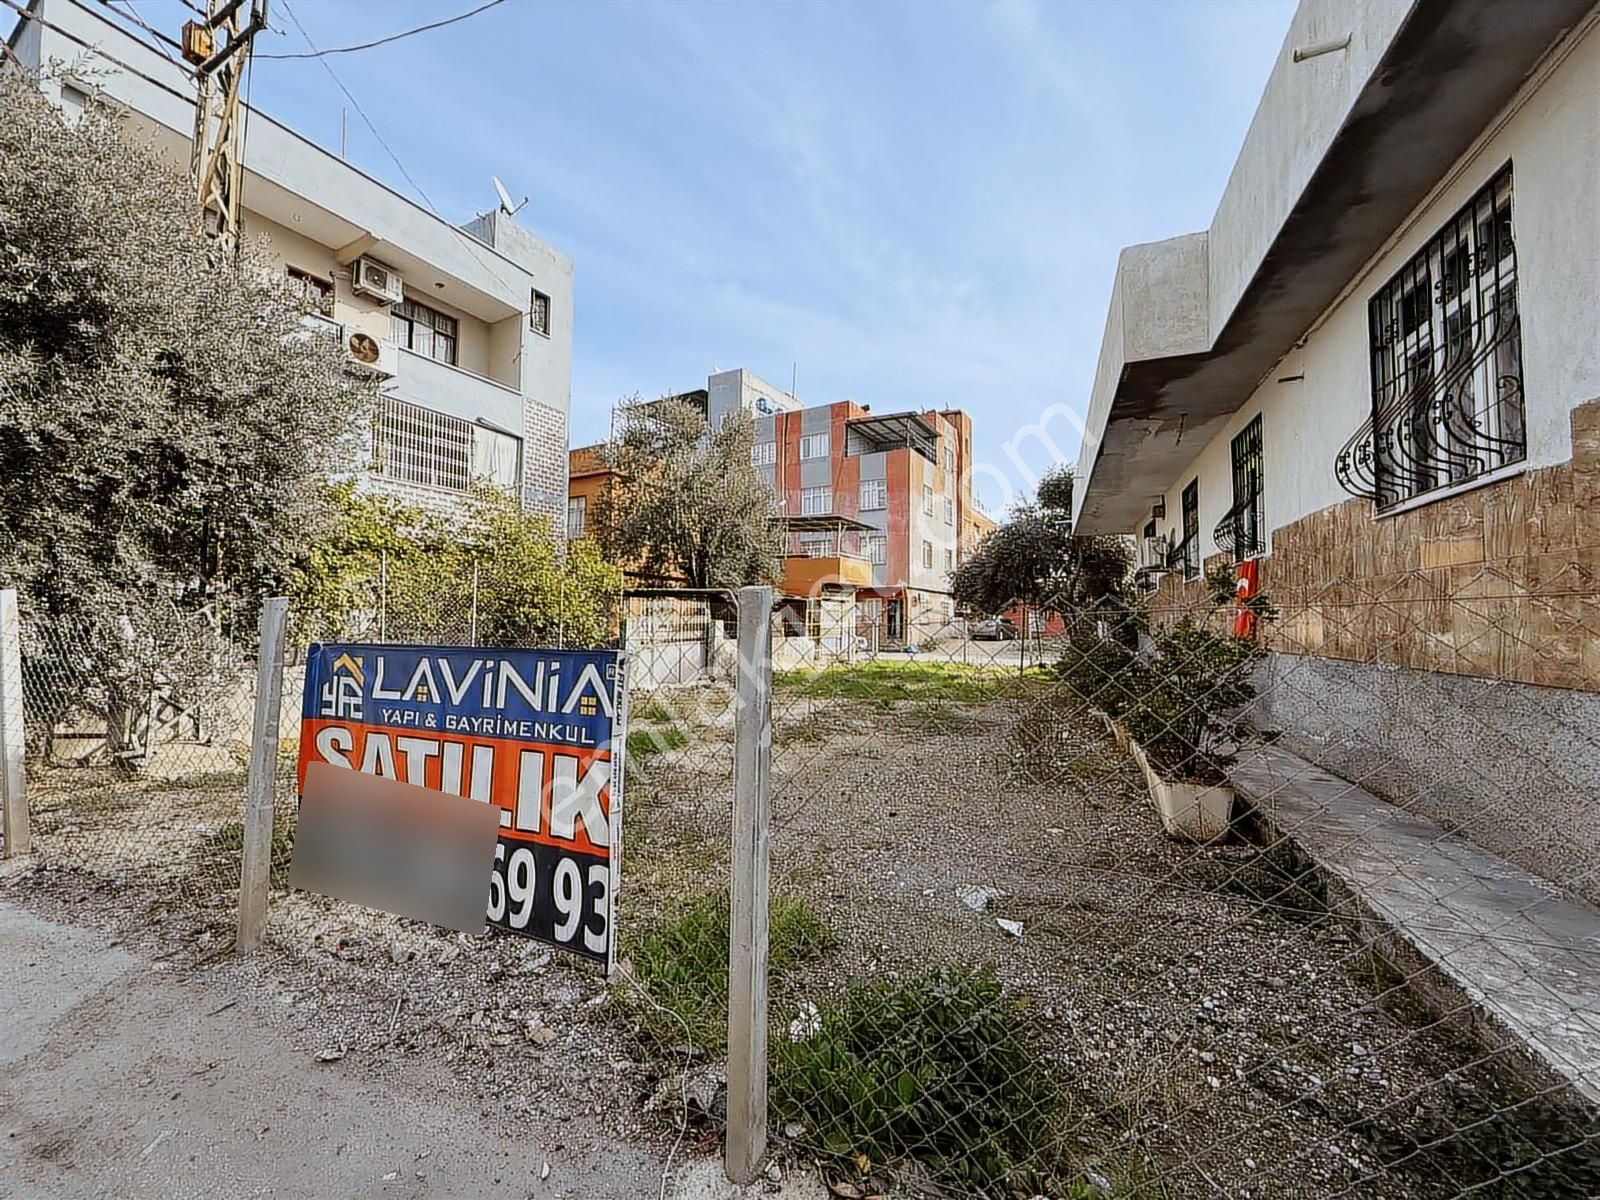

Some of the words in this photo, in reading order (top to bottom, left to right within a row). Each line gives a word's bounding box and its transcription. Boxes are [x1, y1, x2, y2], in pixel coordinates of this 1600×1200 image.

[382, 708, 420, 726] YAPI
[425, 713, 437, 728] &
[446, 714, 595, 744] GAYRİMENKUL
[553, 857, 608, 954] 93
